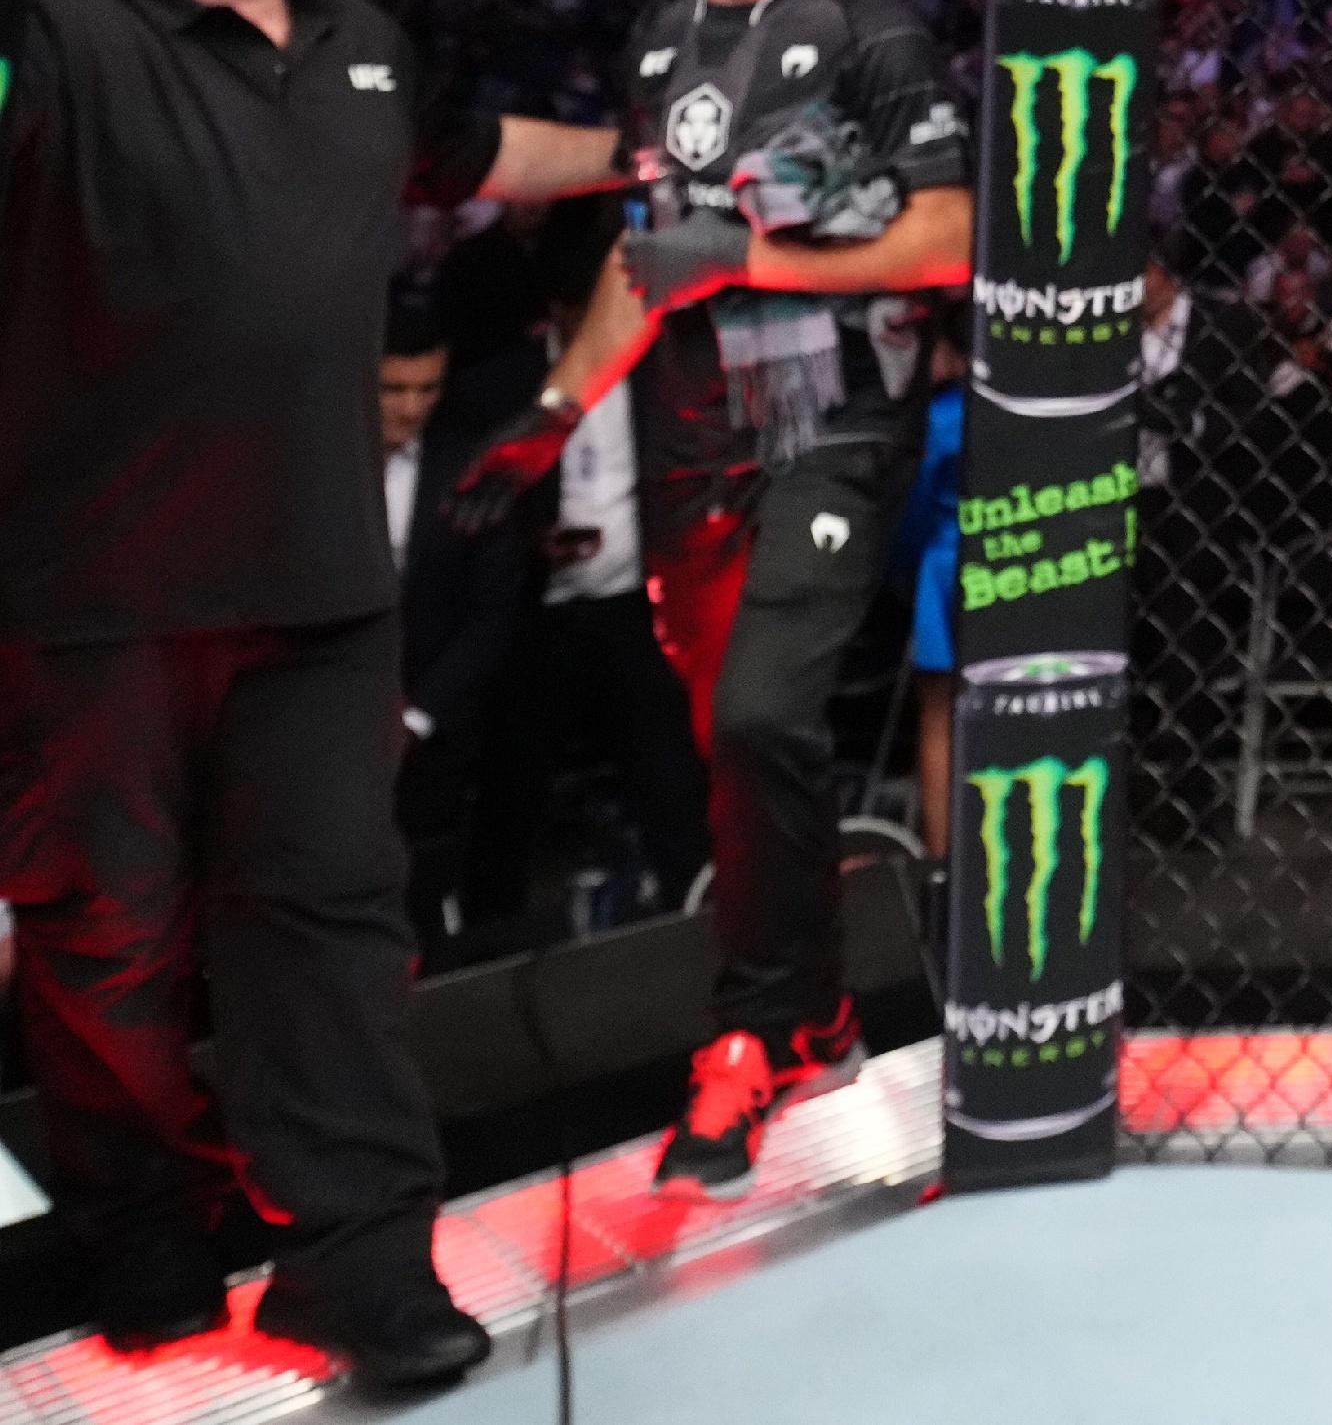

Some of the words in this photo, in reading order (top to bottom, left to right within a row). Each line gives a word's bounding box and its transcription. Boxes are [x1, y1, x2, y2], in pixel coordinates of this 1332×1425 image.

[959, 460, 1138, 536] Unleash
[961, 505, 1138, 611] Beast!
[983, 529, 1043, 561] the
